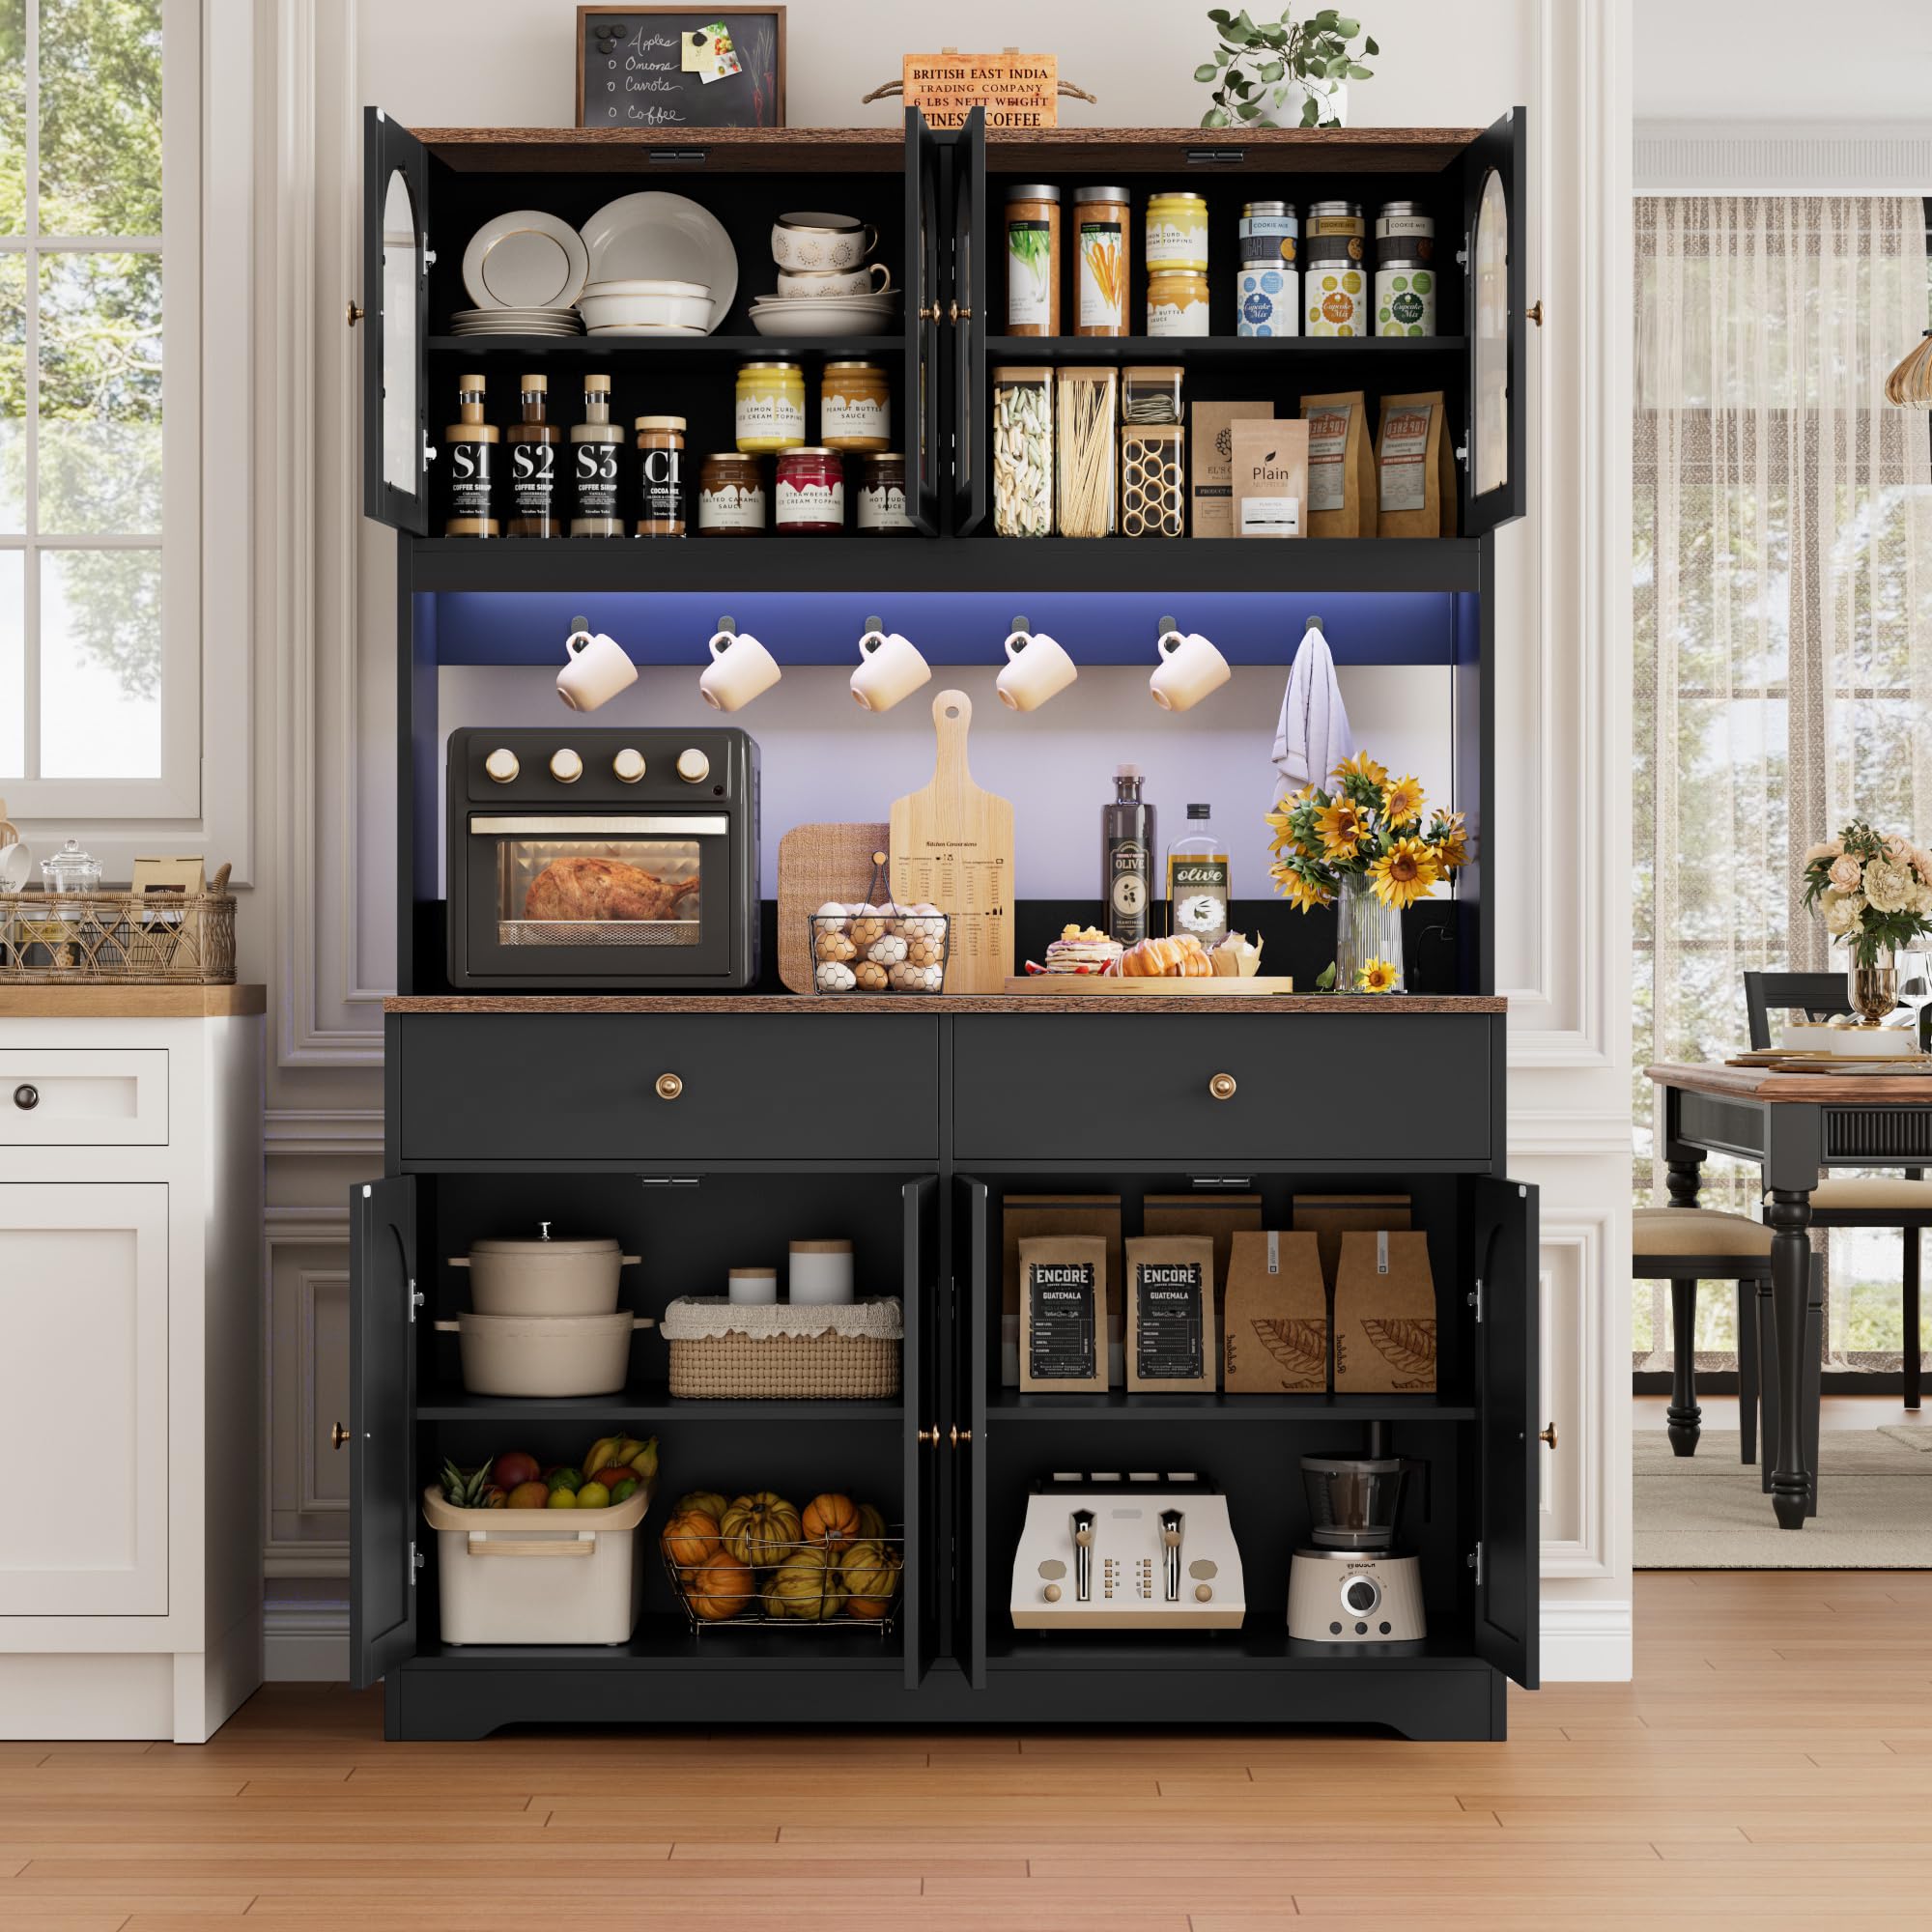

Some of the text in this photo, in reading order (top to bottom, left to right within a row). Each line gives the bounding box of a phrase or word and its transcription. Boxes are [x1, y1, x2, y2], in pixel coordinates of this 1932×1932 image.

[628, 26, 681, 56] Apples
[625, 56, 680, 71] Onions
[913, 69, 1048, 80] BRITISH EAST INDIA
[625, 76, 683, 92] Carrots
[919, 84, 1043, 93] TRADING COMPANY
[914, 98, 1049, 106] 6 LBS NETT WEIGHT
[628, 105, 686, 125] Coffee
[923, 113, 1040, 127] FINES COFFEE
[452, 444, 491, 479] S1
[512, 444, 554, 479] S2
[576, 444, 618, 479] S3
[644, 450, 682, 484] C1
[1253, 467, 1289, 480] Plain
[1115, 859, 1145, 869] OLIVE
[1177, 867, 1223, 882] olive
[1037, 1269, 1089, 1283] ENCORE
[1144, 1269, 1196, 1283] ENCORE
